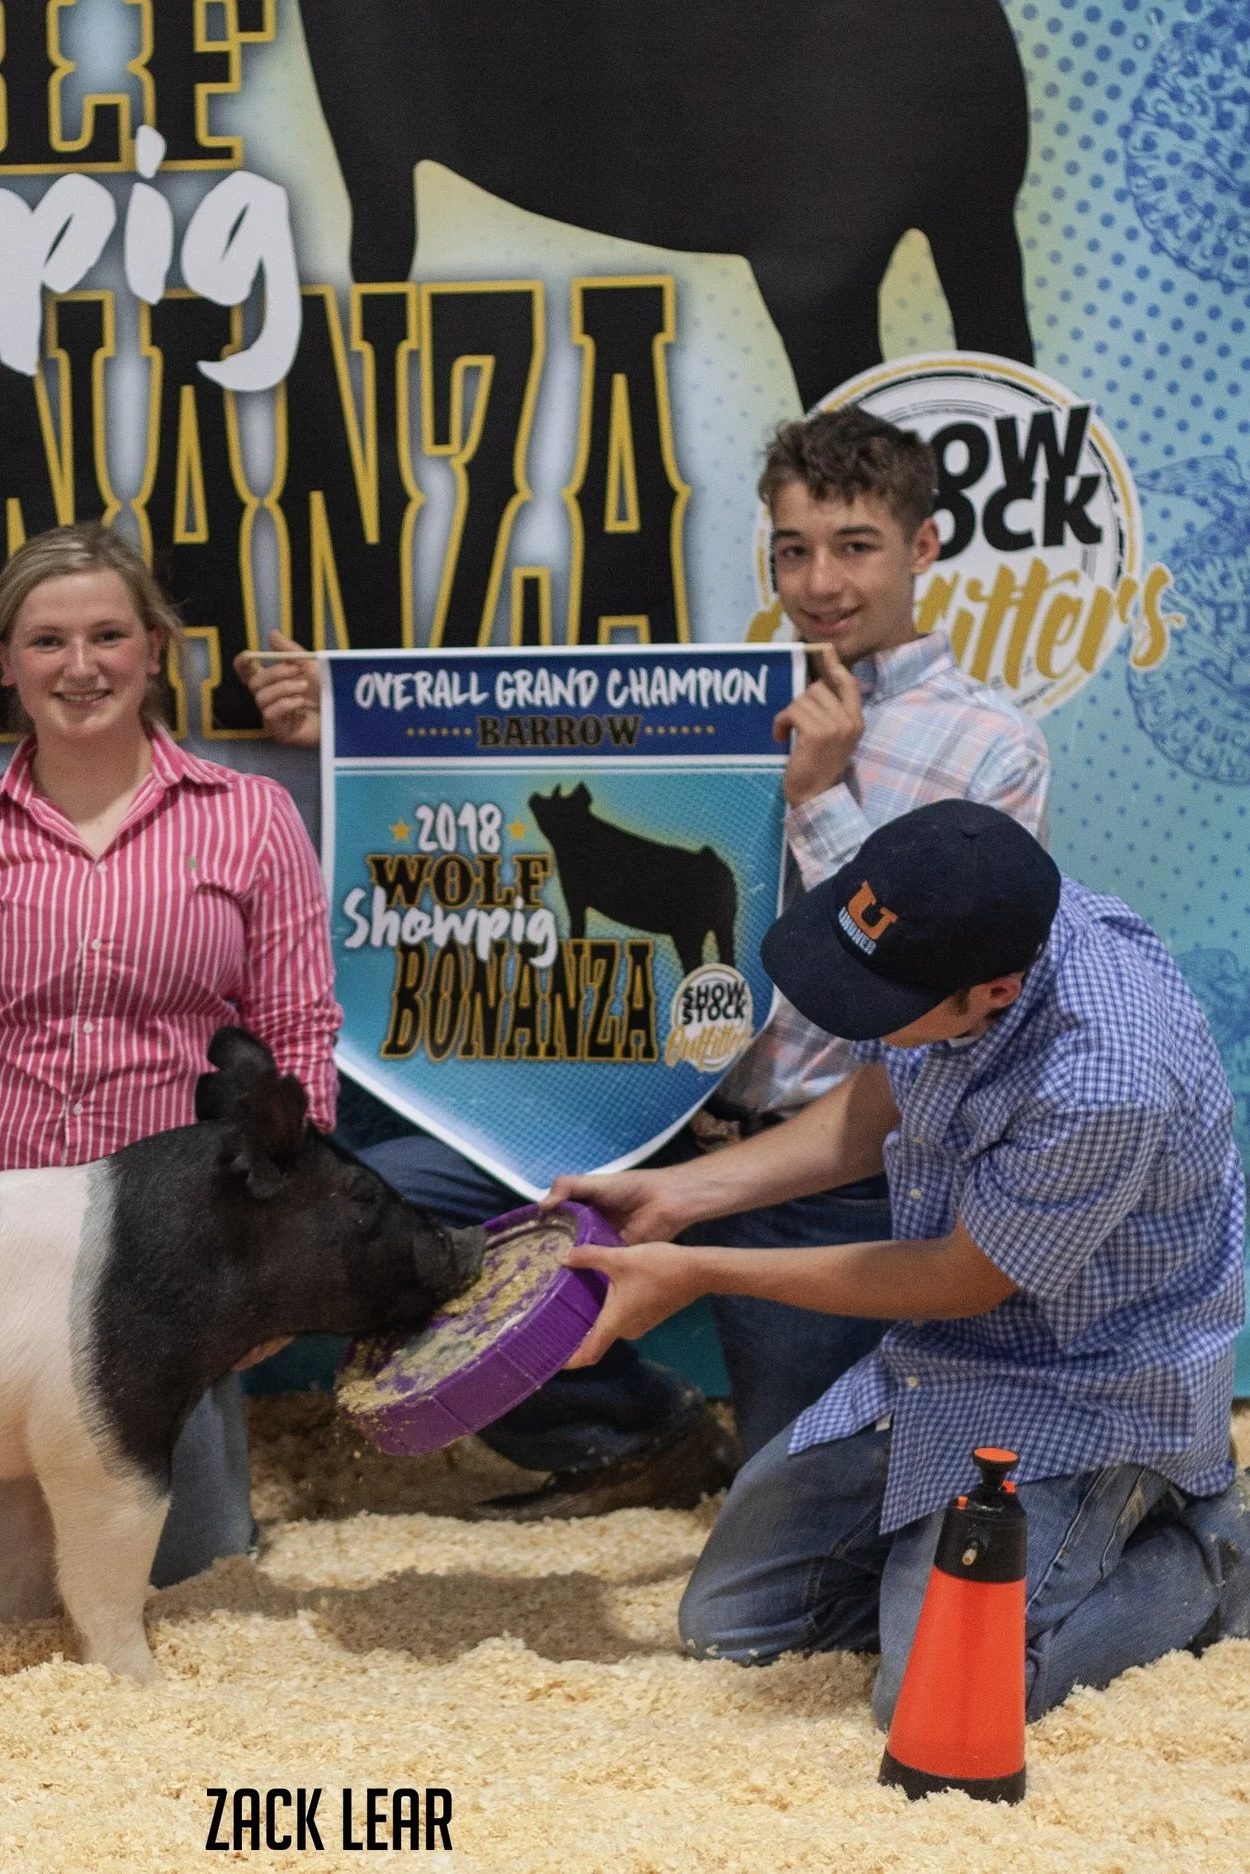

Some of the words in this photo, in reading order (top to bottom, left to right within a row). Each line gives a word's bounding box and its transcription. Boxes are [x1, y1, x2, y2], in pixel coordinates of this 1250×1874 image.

[933, 404, 1093, 492] OW
[935, 473, 1103, 561] OCK
[354, 668, 489, 712] OVERALL
[495, 668, 599, 710] GRAND
[605, 664, 769, 710] CHAMPION
[477, 714, 643, 748] BARROW
[415, 802, 503, 853] 2018
[366, 853, 551, 910] WOLF
[342, 887, 559, 968] Showpig
[380, 938, 659, 1064] BONANZA
[682, 981, 746, 1005] SHOW
[682, 999, 747, 1026] STOCK
